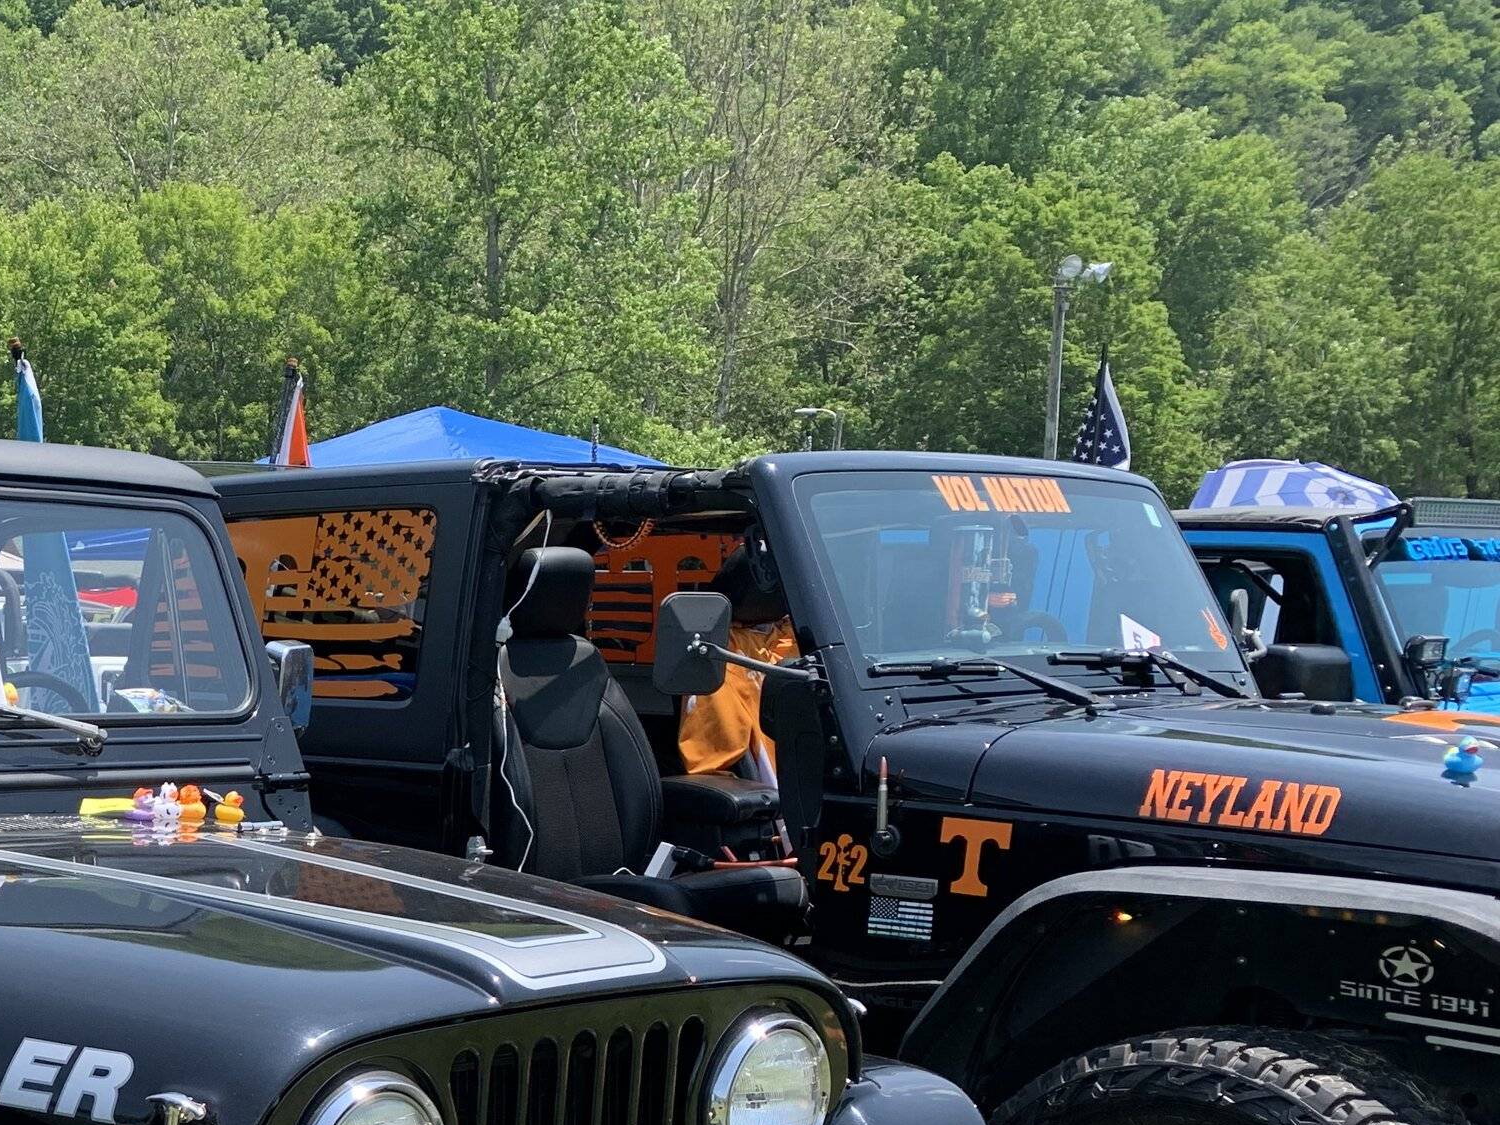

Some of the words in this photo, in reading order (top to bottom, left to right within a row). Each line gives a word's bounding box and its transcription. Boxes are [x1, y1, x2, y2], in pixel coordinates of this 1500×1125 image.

[931, 474, 990, 512] VOL
[980, 475, 1072, 514] NATION
[1139, 768, 1342, 836] NEYLAND
[940, 816, 1013, 897] T
